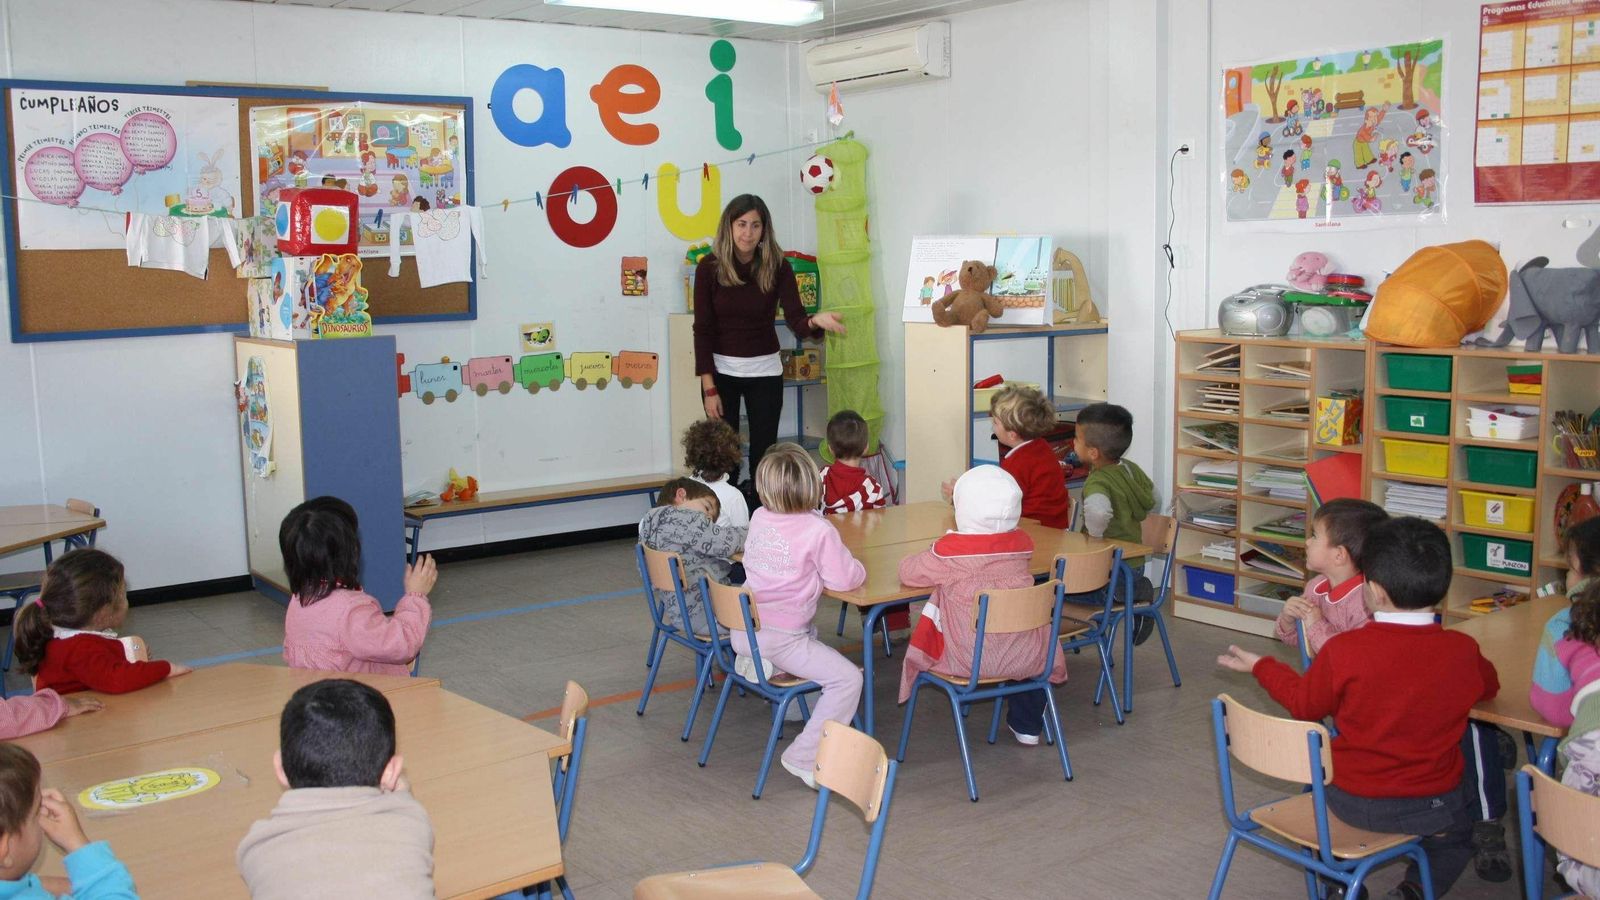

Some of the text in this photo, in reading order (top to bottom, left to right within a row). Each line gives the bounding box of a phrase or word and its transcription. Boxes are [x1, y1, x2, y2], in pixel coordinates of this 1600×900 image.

[1483, 4, 1526, 15] Programas
[490, 39, 743, 151] a e i
[20, 96, 119, 115] CUMPLEAÑOS
[657, 162, 721, 241] u
[321, 322, 369, 335] DINOSAURIOS
